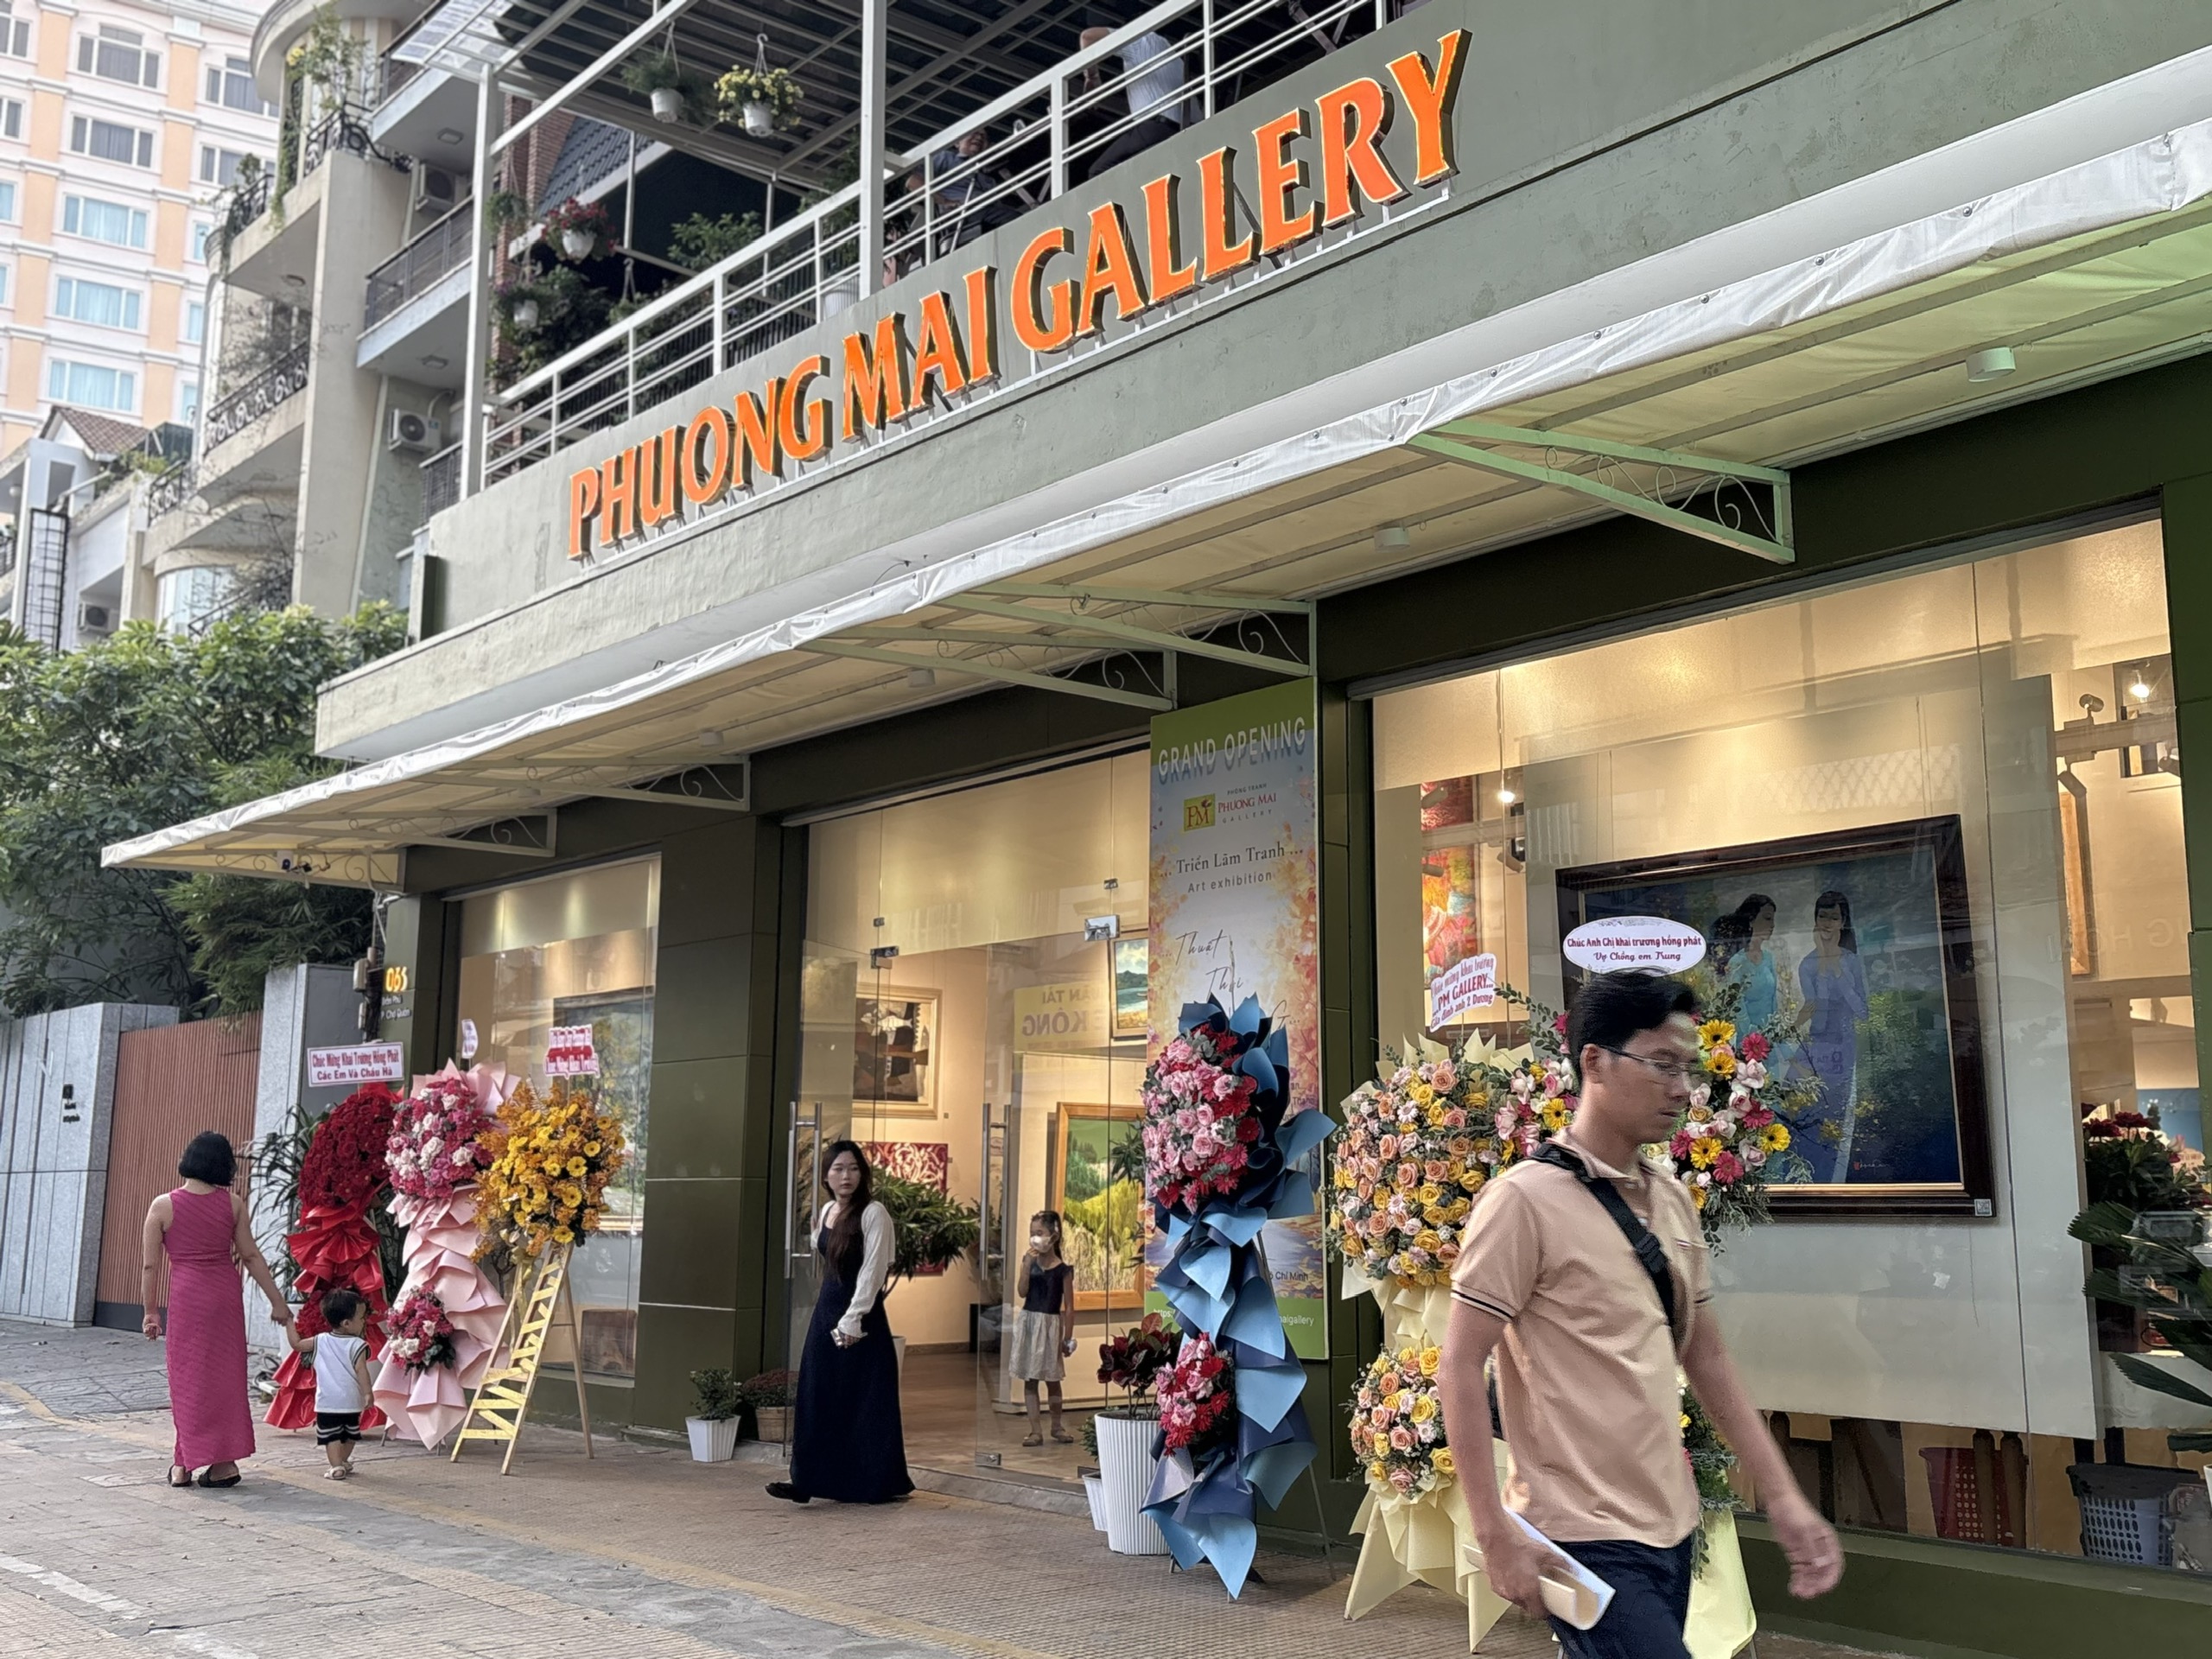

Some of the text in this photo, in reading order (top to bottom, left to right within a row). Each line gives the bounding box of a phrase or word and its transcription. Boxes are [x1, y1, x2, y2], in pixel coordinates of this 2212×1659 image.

[567, 28, 1471, 561] PHUONG MAI GALLERY
[1158, 716, 1306, 777] GRAND OPENING
[1258, 791, 1277, 805] MAI
[1222, 808, 1272, 824] GALLERY
[1214, 853, 1241, 868] Lãm
[1245, 841, 1285, 862] Tranh
[1187, 871, 1272, 893] Art exhibition
[1567, 938, 1586, 948] Chúc
[1586, 938, 1601, 947] Anh
[1616, 937, 1631, 947] khai
[1683, 935, 1702, 947] phát
[334, 1070, 346, 1079] Em
